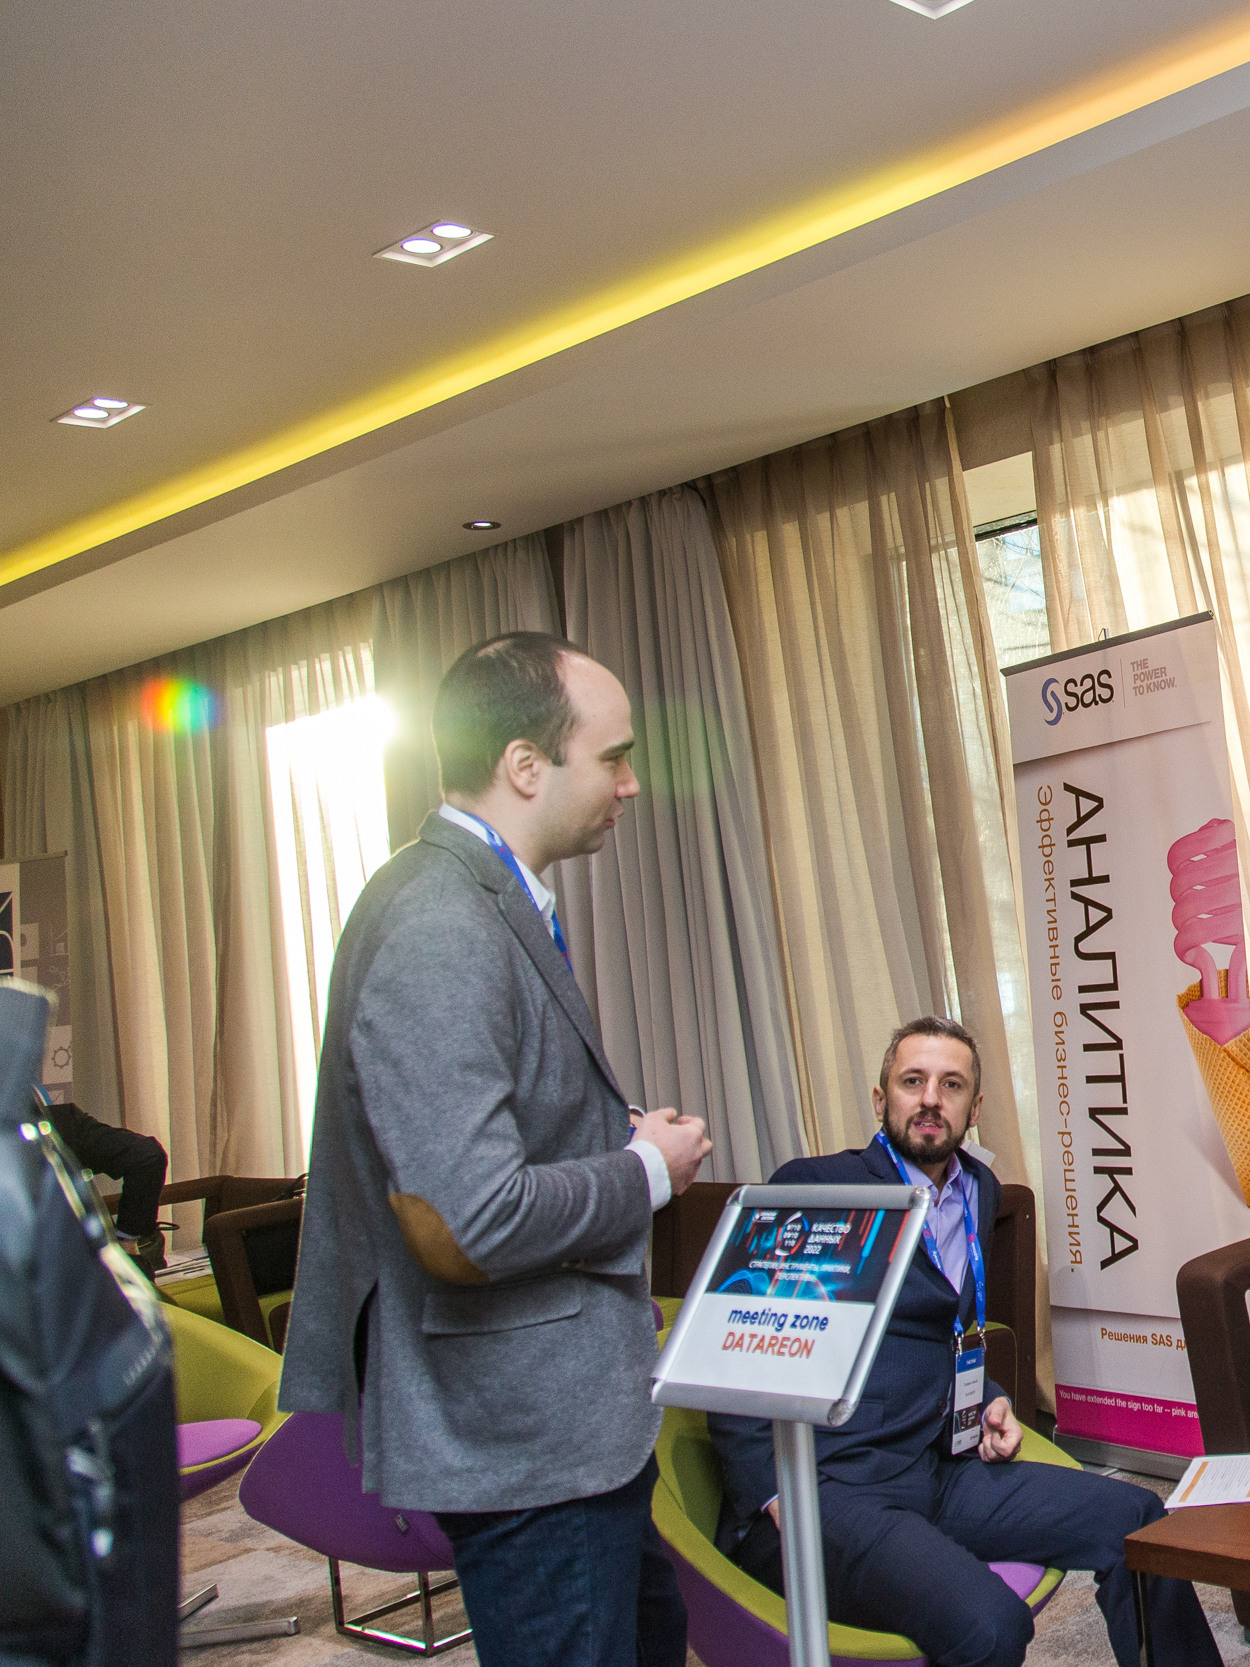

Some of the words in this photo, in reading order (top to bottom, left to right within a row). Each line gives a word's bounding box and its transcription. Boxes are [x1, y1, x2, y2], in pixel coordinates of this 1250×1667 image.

[1130, 658, 1149, 672] THE
[1133, 666, 1167, 684] POWER
[1064, 669, 1114, 712] sas
[1132, 685, 1145, 697] TO
[1146, 677, 1177, 694] KNOW.
[1036, 785, 1063, 1000] Эффективные
[1053, 1011, 1083, 1273] бизнес-решения.
[1063, 781, 1139, 1271] АНАЛИТИКА
[727, 1307, 788, 1332] meeting
[790, 1314, 829, 1332] zone
[721, 1331, 816, 1359] DATAREON
[1100, 1327, 1148, 1344] Решения
[1151, 1333, 1173, 1347] SAS
[1059, 1390, 1070, 1400] You
[1071, 1393, 1086, 1402] have
[1087, 1396, 1115, 1406] extended
[1116, 1398, 1127, 1408] the
[1127, 1400, 1141, 1411] sign
[1142, 1402, 1154, 1412] too
[1154, 1403, 1163, 1413] far
[1171, 1407, 1186, 1417] pink
